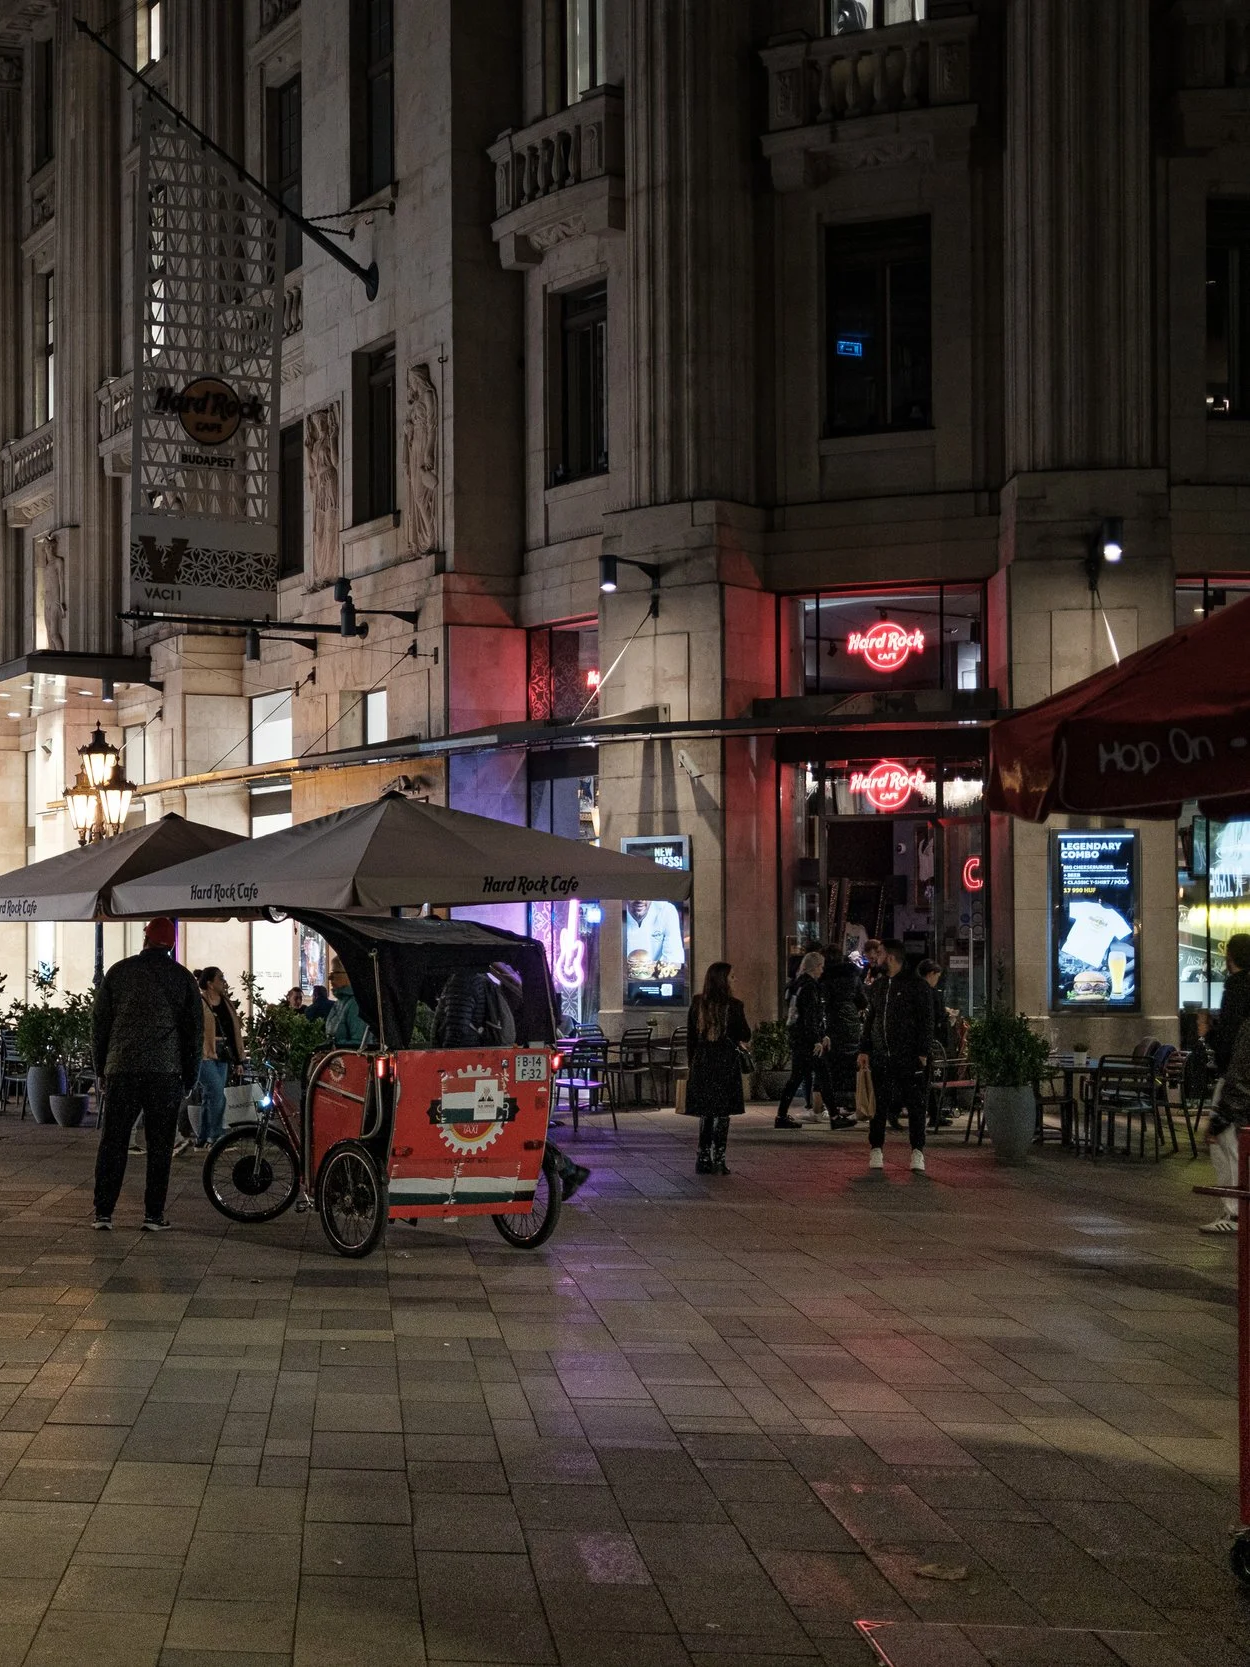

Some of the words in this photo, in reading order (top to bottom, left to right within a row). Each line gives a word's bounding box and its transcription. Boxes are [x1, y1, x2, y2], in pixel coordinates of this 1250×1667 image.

[154, 387, 207, 414] Hard
[212, 392, 265, 425] Rock
[181, 453, 236, 468] BUDAPEST
[145, 586, 175, 600] VÁCI
[177, 590, 182, 601] 1
[847, 630, 886, 652] Hard
[888, 628, 925, 653] Rock
[1098, 740, 1160, 775] Hop
[1169, 727, 1215, 764] On
[850, 772, 889, 792] Hard
[889, 768, 926, 792] Rock
[654, 847, 673, 857] NEW
[1061, 842, 1122, 851] LEGENDARY
[1061, 851, 1099, 859] COMBO
[190, 884, 212, 901] Hard
[214, 883, 236, 902] Rock
[237, 882, 259, 900] Cafe
[482, 875, 516, 892] Hard
[517, 875, 549, 895] Rock
[550, 875, 579, 895] Cafe
[7, 899, 22, 916] Rock
[22, 899, 37, 915] Cafe
[522, 1056, 542, 1067] B-14
[521, 1069, 541, 1080] F-32
[463, 1124, 479, 1134] TAXI
